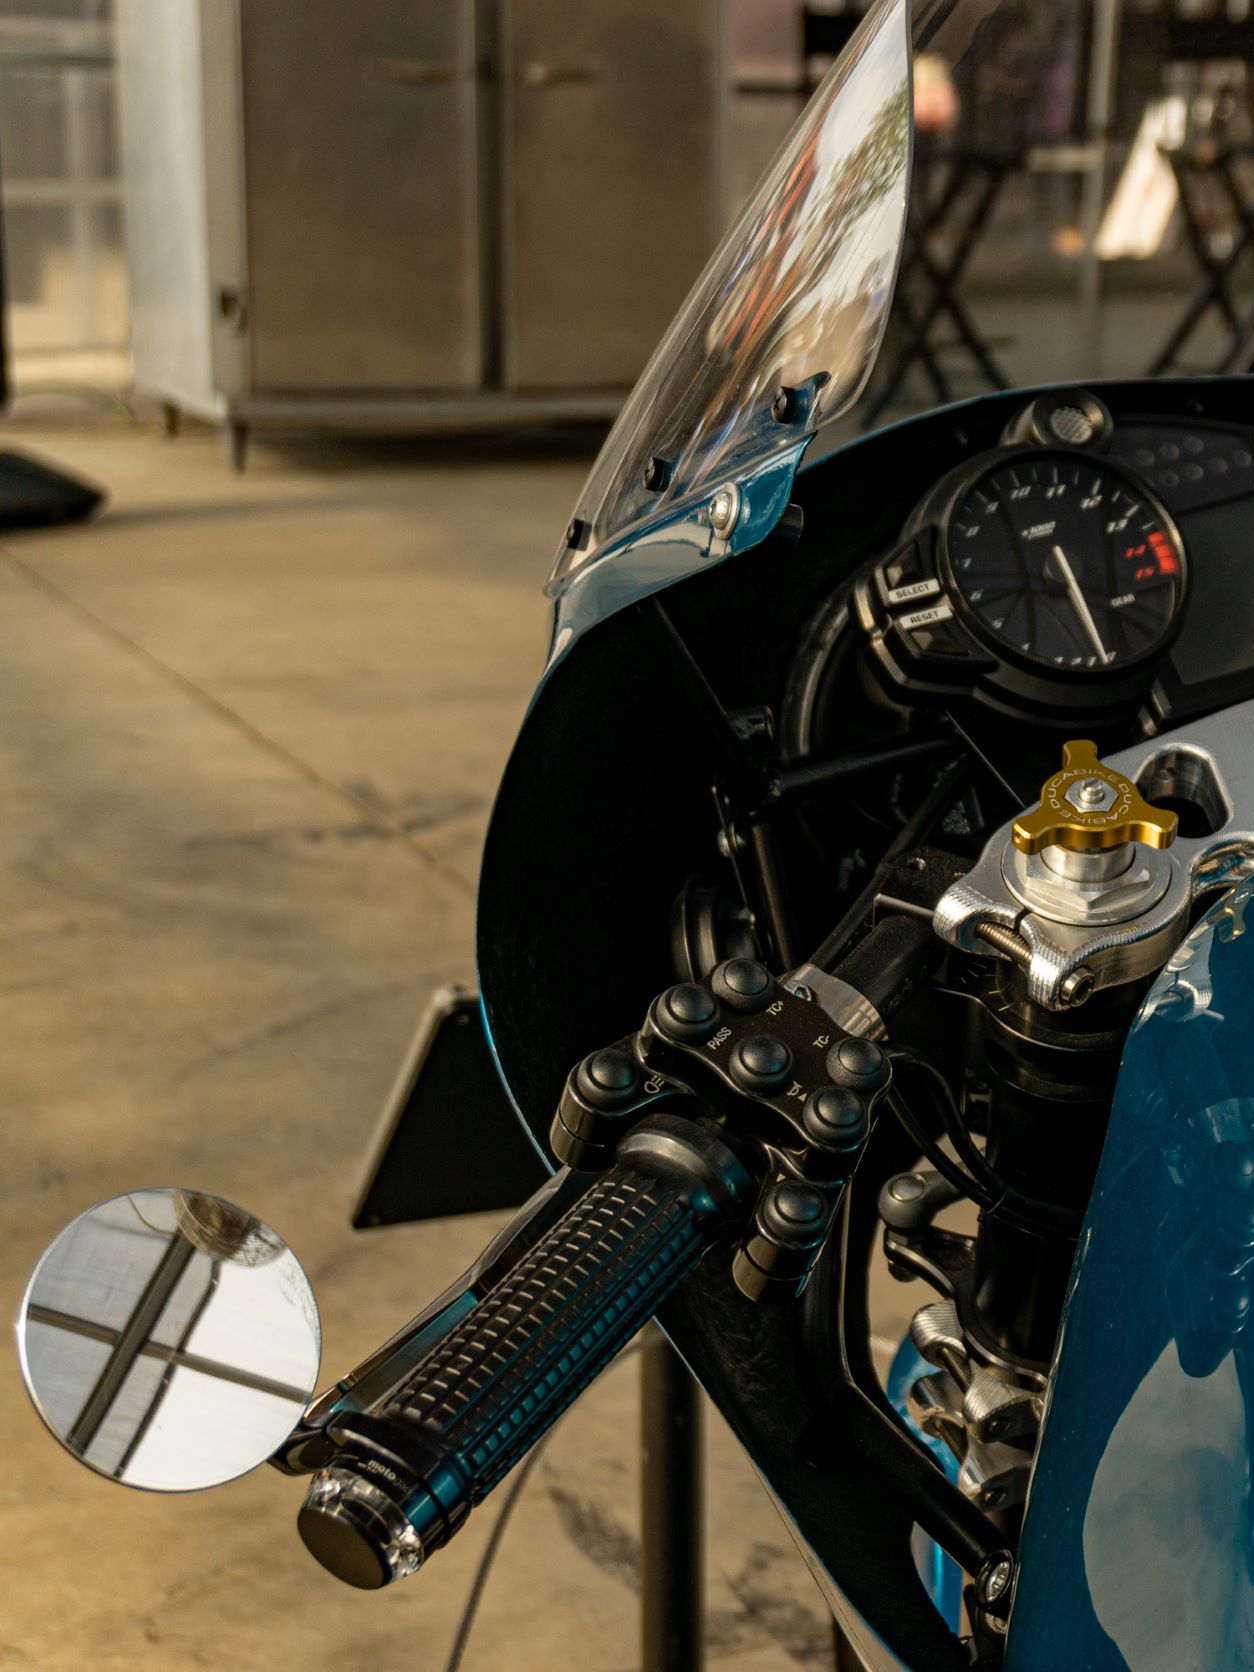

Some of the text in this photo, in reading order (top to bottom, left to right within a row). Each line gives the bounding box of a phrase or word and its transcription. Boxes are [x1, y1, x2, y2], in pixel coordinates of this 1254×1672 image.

[1046, 484, 1066, 499] 11
[1081, 495, 1103, 511] 12
[1106, 518, 1128, 534] 13
[1125, 544, 1147, 559] 14
[895, 582, 930, 599] SELECT
[1110, 593, 1136, 608] GEAR
[909, 610, 940, 624] RESET
[1048, 768, 1120, 809] DUCABIKE
[765, 1000, 784, 1016] TC+
[706, 1026, 732, 1050] PASS
[813, 1034, 830, 1048] TC-
